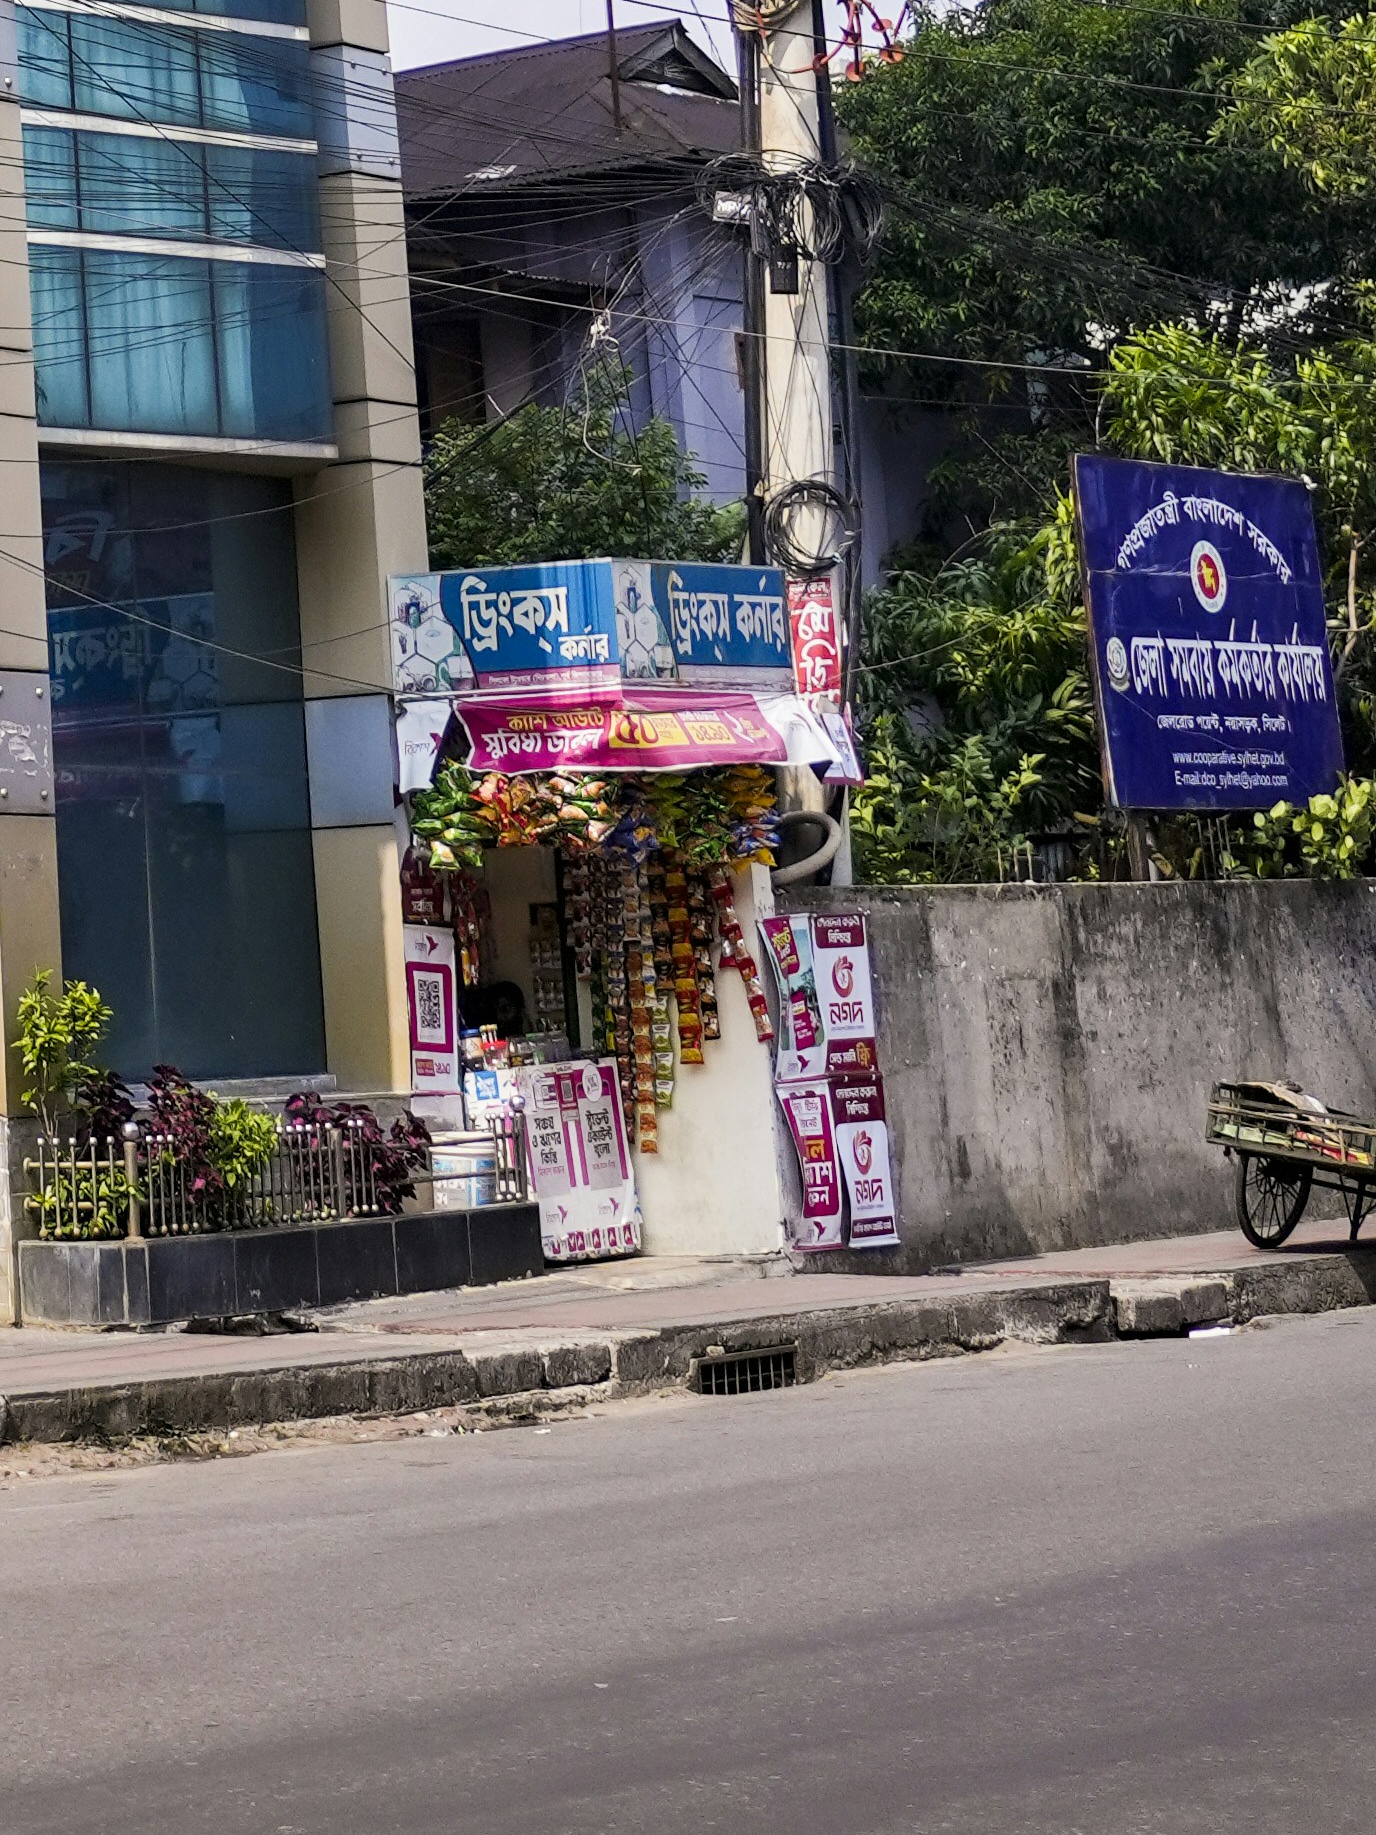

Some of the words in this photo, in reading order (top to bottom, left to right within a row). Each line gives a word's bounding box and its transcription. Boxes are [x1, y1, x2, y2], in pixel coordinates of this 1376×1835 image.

[1181, 495, 1244, 536] বাংলাদেশ
[1246, 518, 1292, 585] সরকার
[1166, 631, 1216, 700] সমবায়
[1274, 621, 1327, 704] কার্যালয়
[828, 1001, 864, 1025] নগদ
